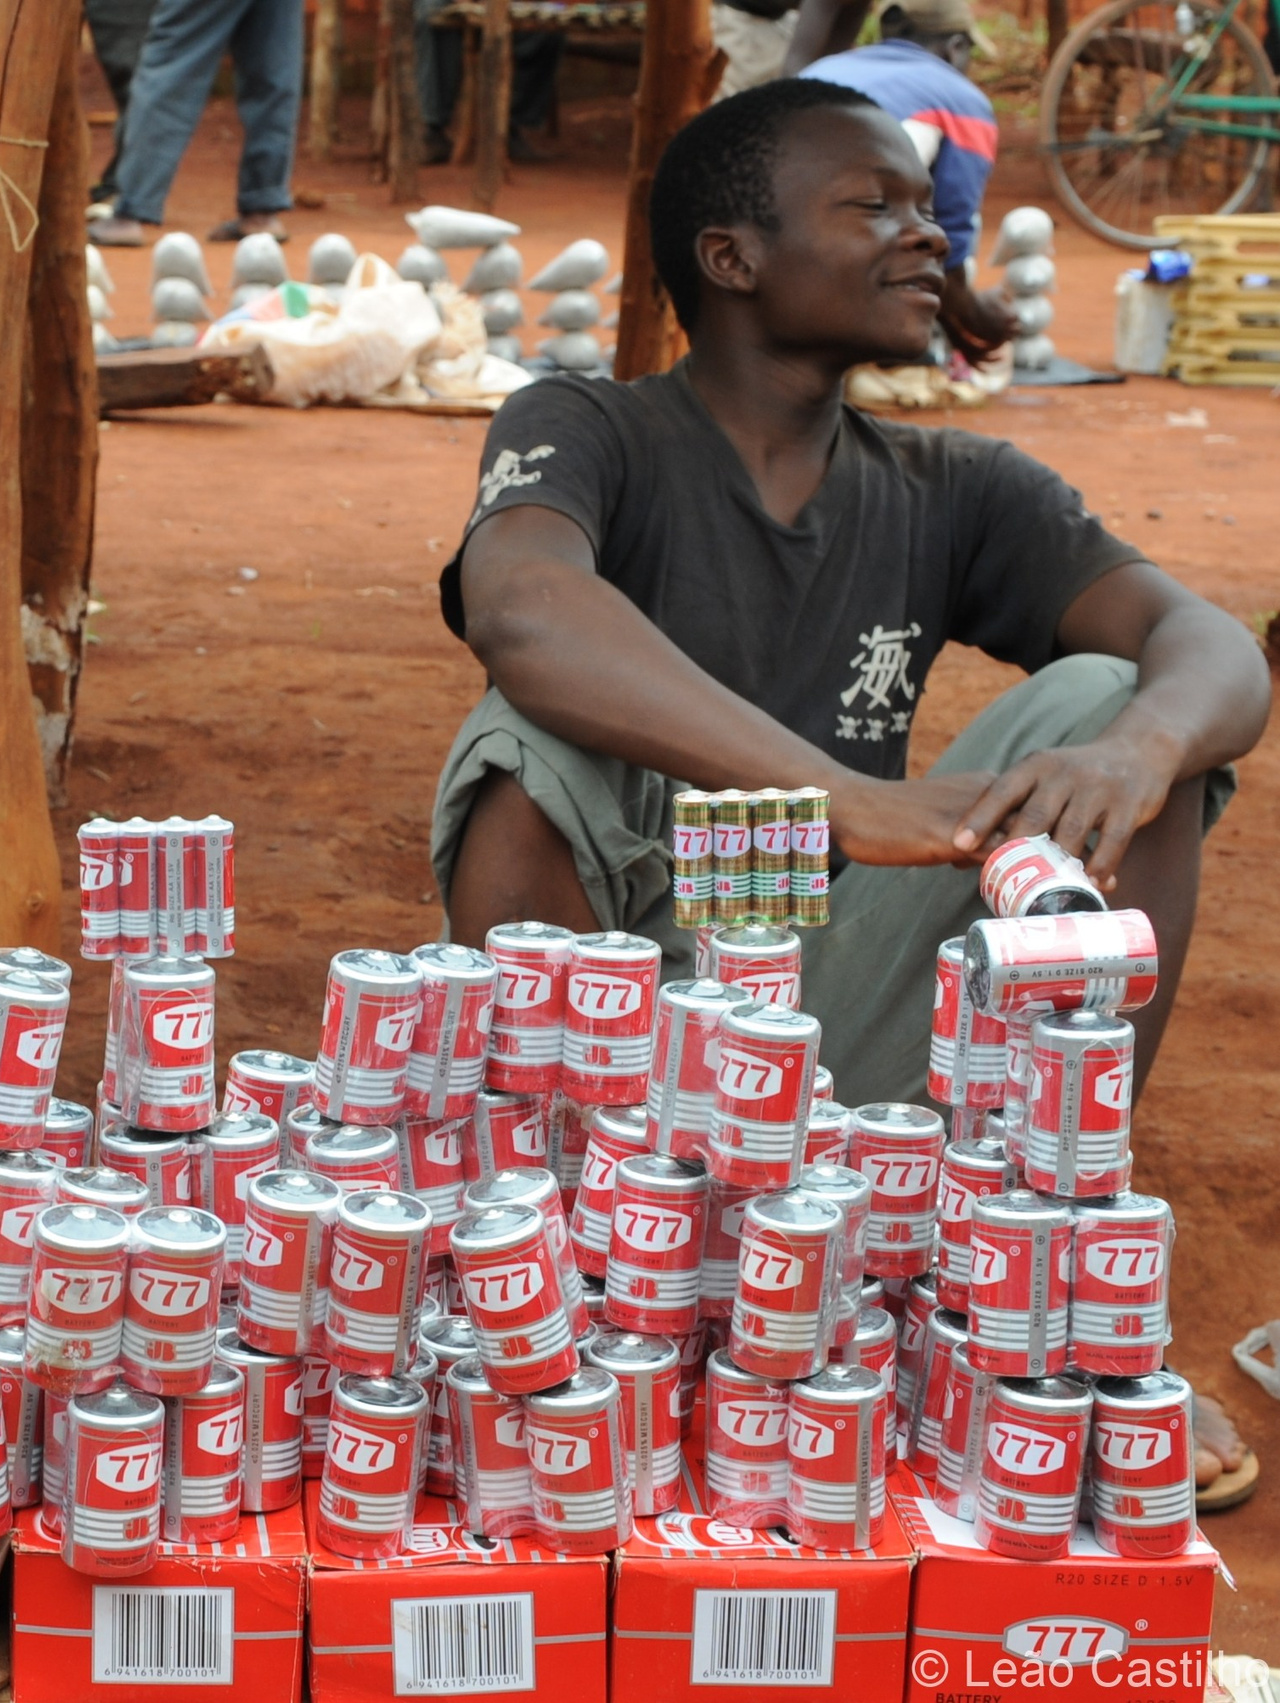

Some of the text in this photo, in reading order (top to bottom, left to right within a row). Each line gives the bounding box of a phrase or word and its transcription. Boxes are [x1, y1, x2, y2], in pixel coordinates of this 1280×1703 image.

[575, 979, 632, 1010] 777
[871, 1160, 931, 1187] 777
[622, 1209, 682, 1244] 777
[1098, 1247, 1159, 1276] 777
[52, 1273, 115, 1304] 777
[138, 1272, 200, 1308] 777
[470, 1268, 530, 1302] 777
[728, 1407, 788, 1436] 777
[332, 1426, 384, 1467] 777
[995, 1428, 1055, 1468] 777
[1098, 1427, 1159, 1460] 777
[1056, 1573, 1085, 1585] R20
[1093, 1574, 1129, 1586] SIZE
[1138, 1575, 1146, 1586] D
[1027, 1626, 1105, 1657] 777
